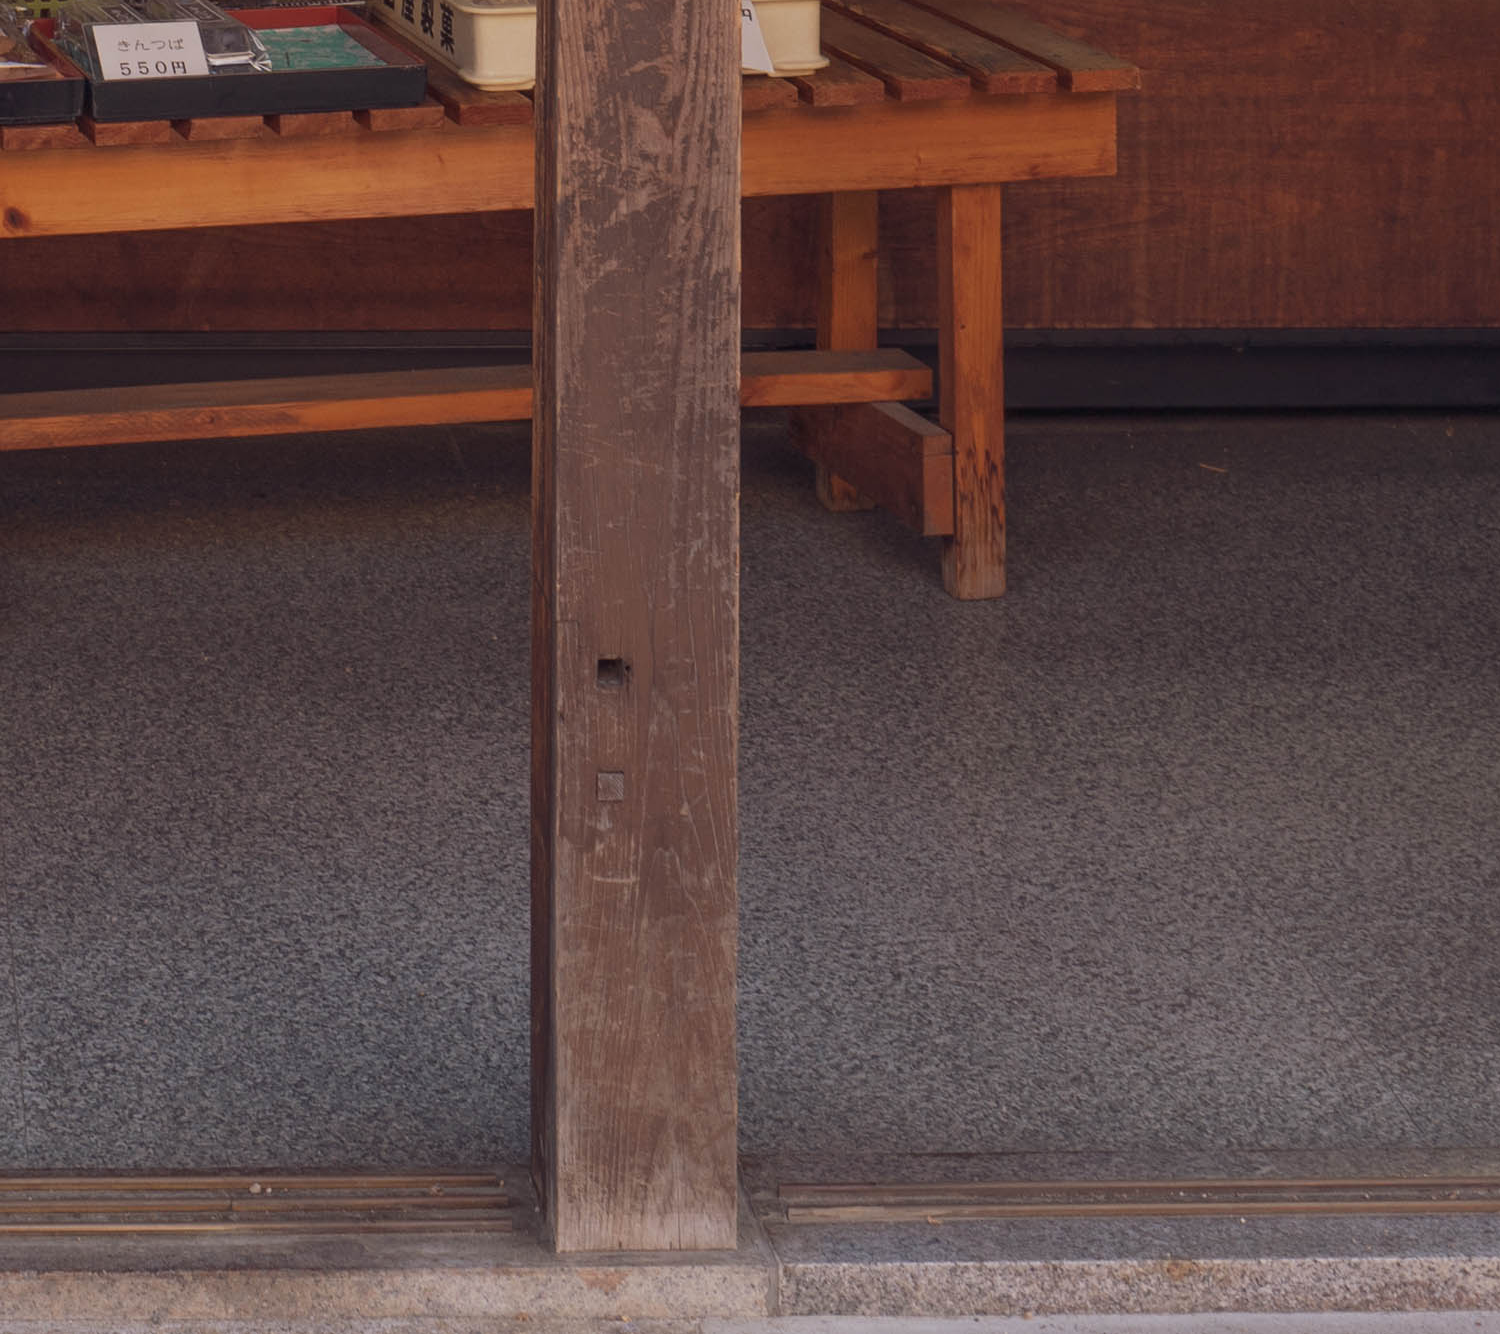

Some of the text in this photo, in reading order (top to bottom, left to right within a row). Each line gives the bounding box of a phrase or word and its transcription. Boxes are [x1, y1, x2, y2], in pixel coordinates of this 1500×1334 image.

[117, 36, 185, 52] きんつば
[119, 60, 188, 76] 550円
